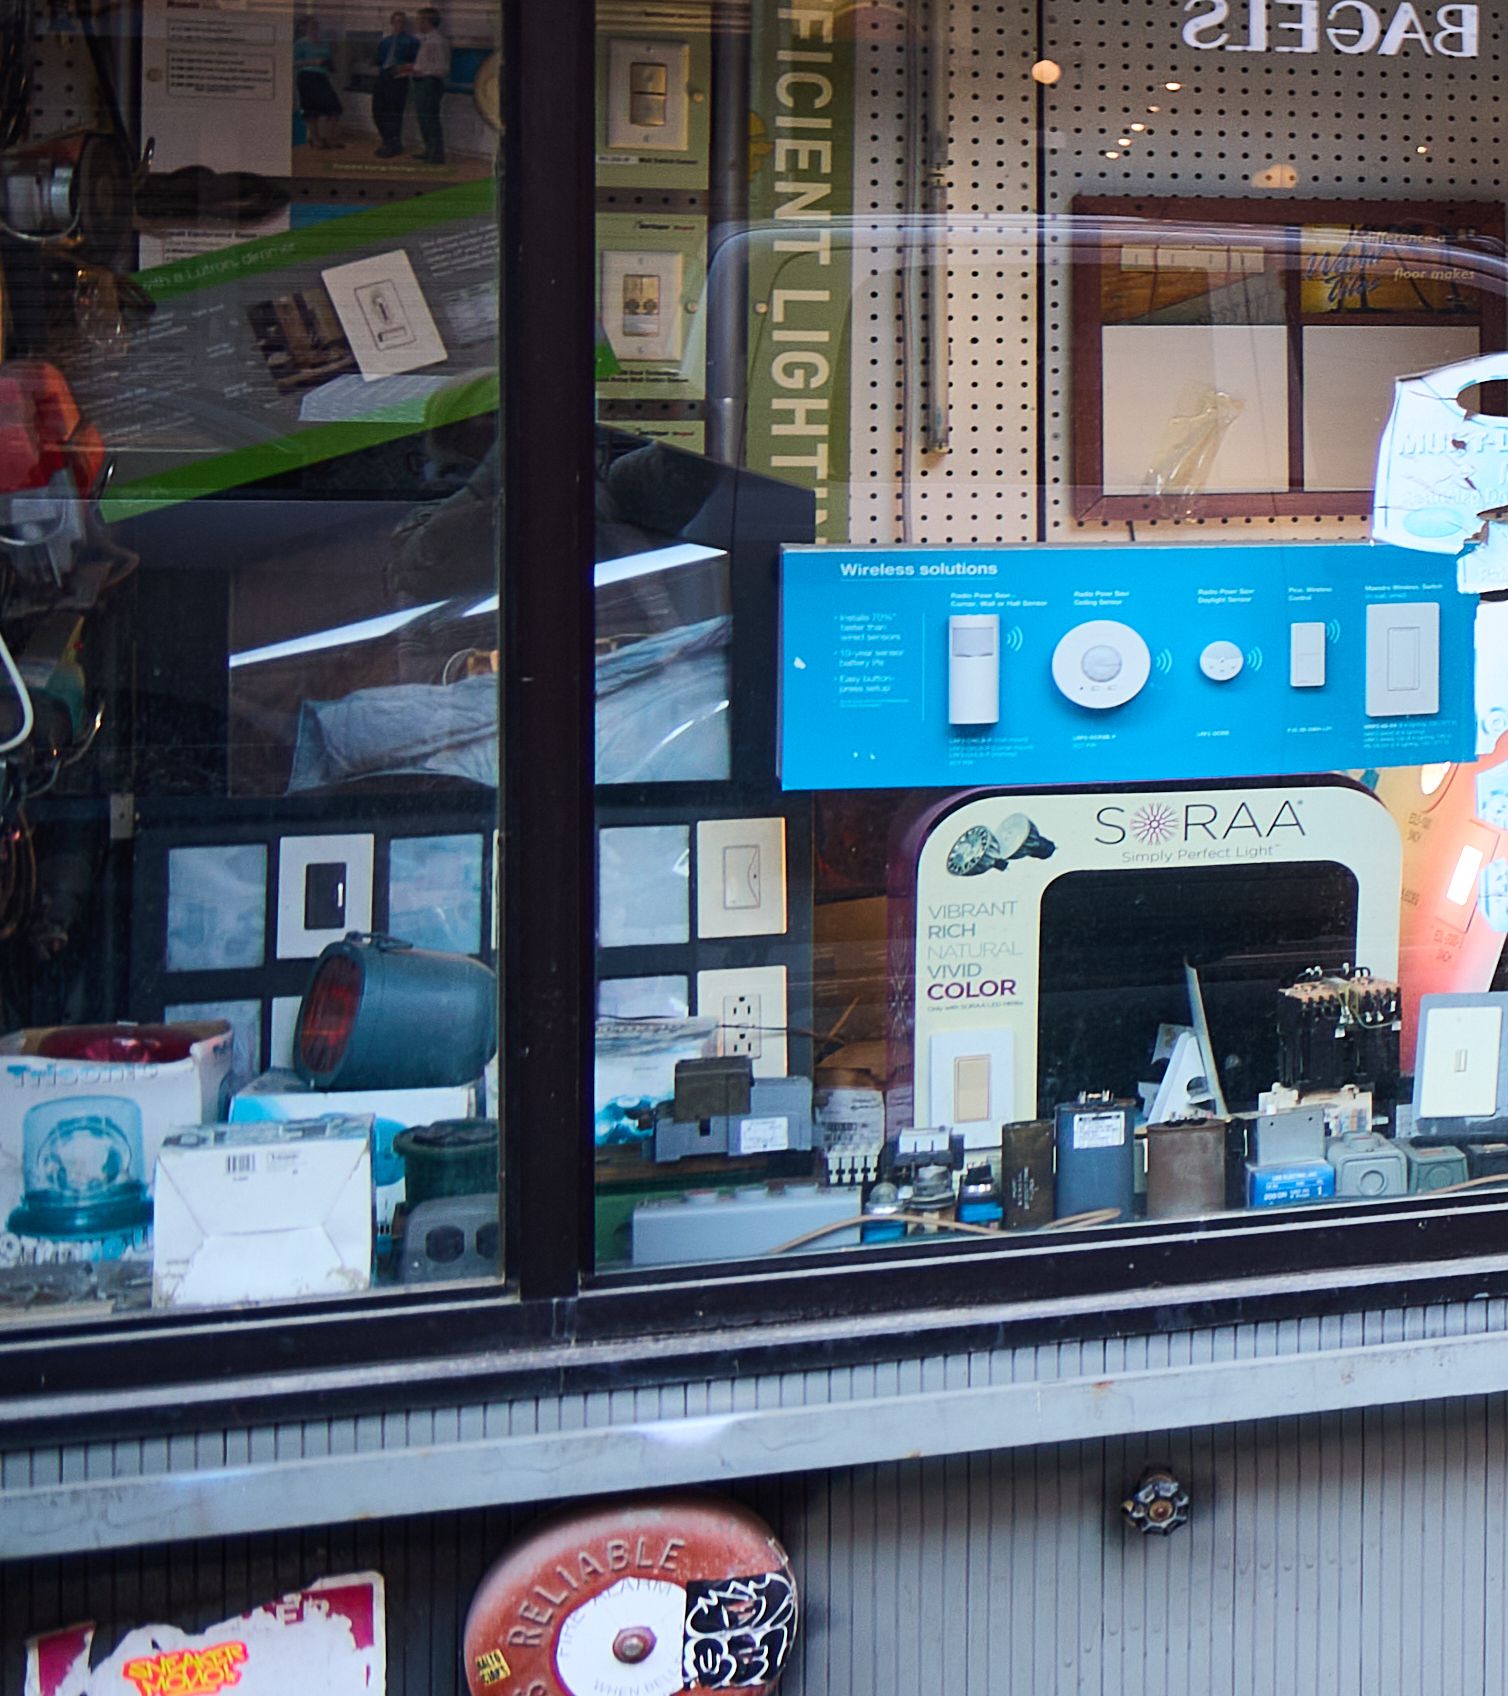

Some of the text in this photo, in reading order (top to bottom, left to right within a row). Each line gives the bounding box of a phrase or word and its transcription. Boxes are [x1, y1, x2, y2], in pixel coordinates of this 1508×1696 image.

[1394, 268, 1476, 282] floor makes
[840, 561, 997, 576] Wireless solutions
[1122, 849, 1174, 864] Simply
[1178, 846, 1231, 860] Perfect
[928, 900, 1019, 919] VIBRANT
[928, 923, 975, 939] RICH
[928, 941, 1023, 960] NATURAL
[928, 963, 982, 979] VIVID
[927, 979, 1017, 1001] COLOR
[508, 1537, 686, 1649] RELIABLE
